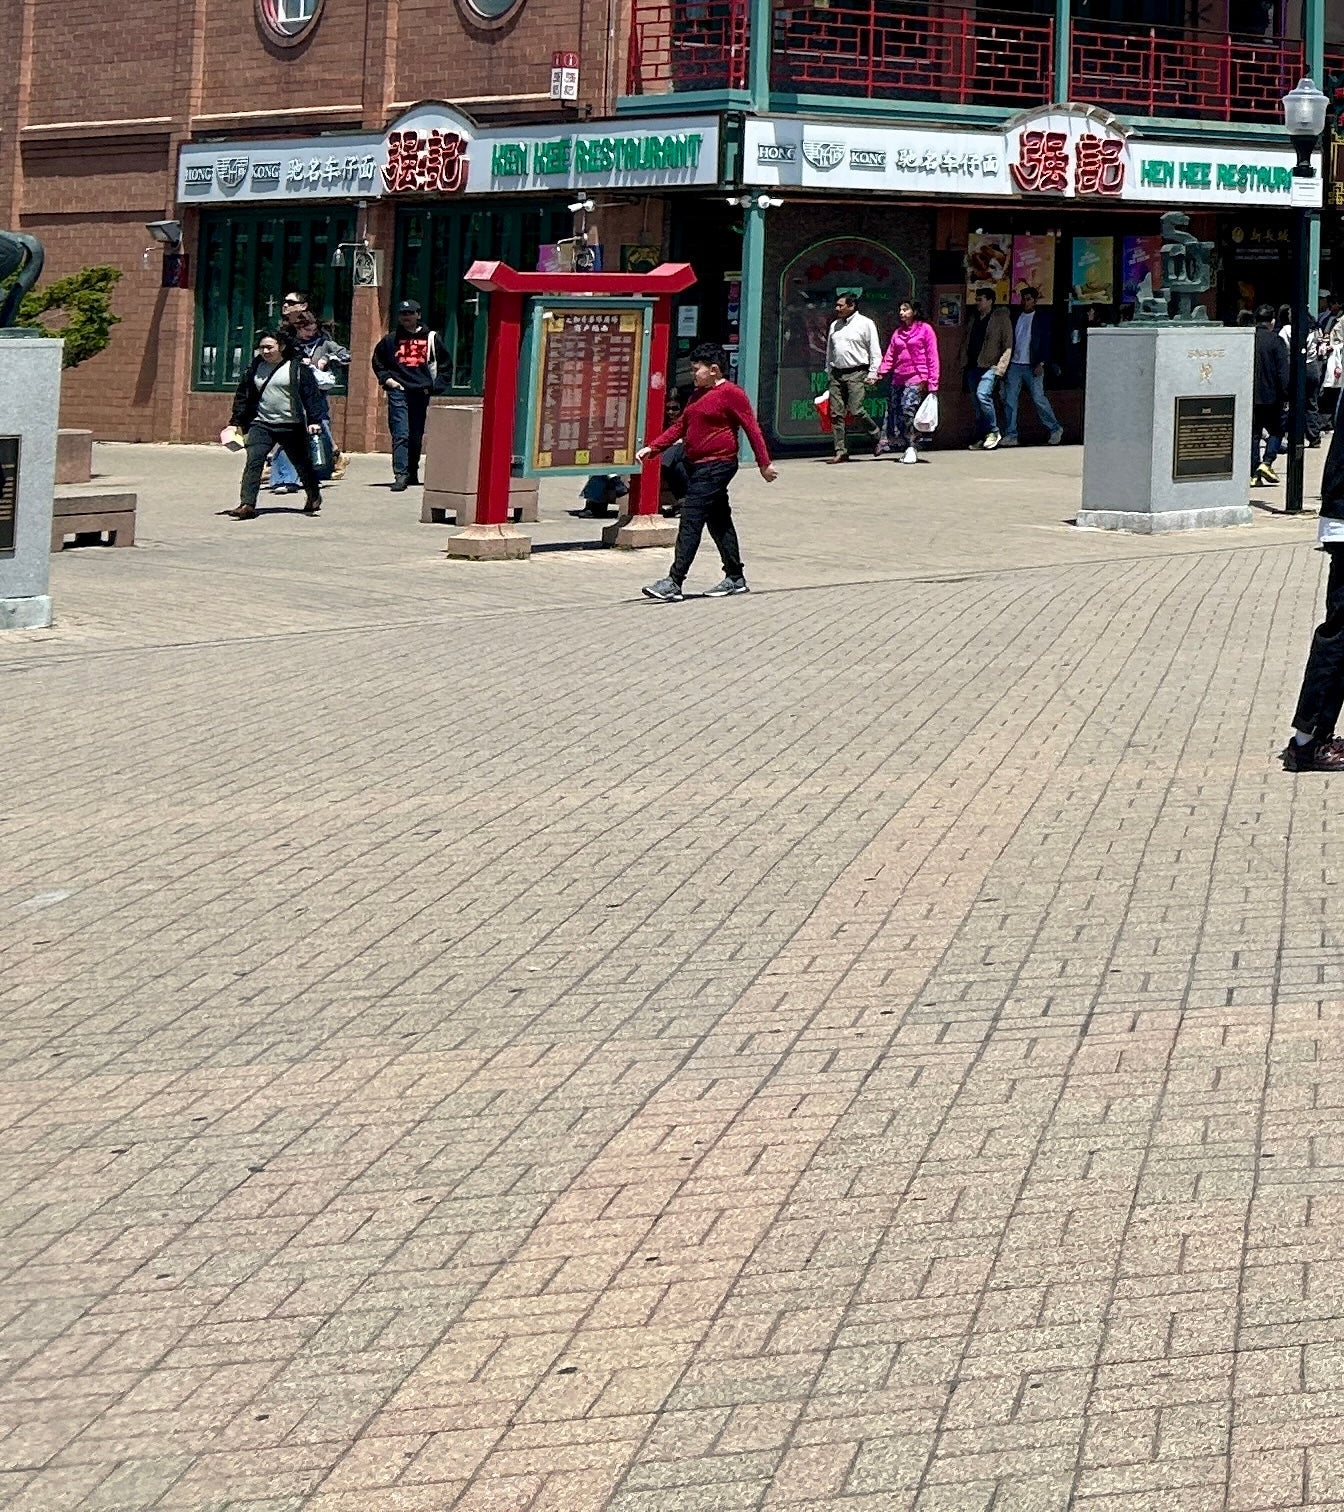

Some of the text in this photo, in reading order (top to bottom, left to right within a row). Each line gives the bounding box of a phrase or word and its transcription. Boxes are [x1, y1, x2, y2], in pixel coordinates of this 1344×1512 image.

[532, 139, 572, 174] KEE
[574, 134, 704, 174] RESTAURANT
[757, 143, 886, 167] HONG KONG
[185, 162, 280, 184] HONG KONG
